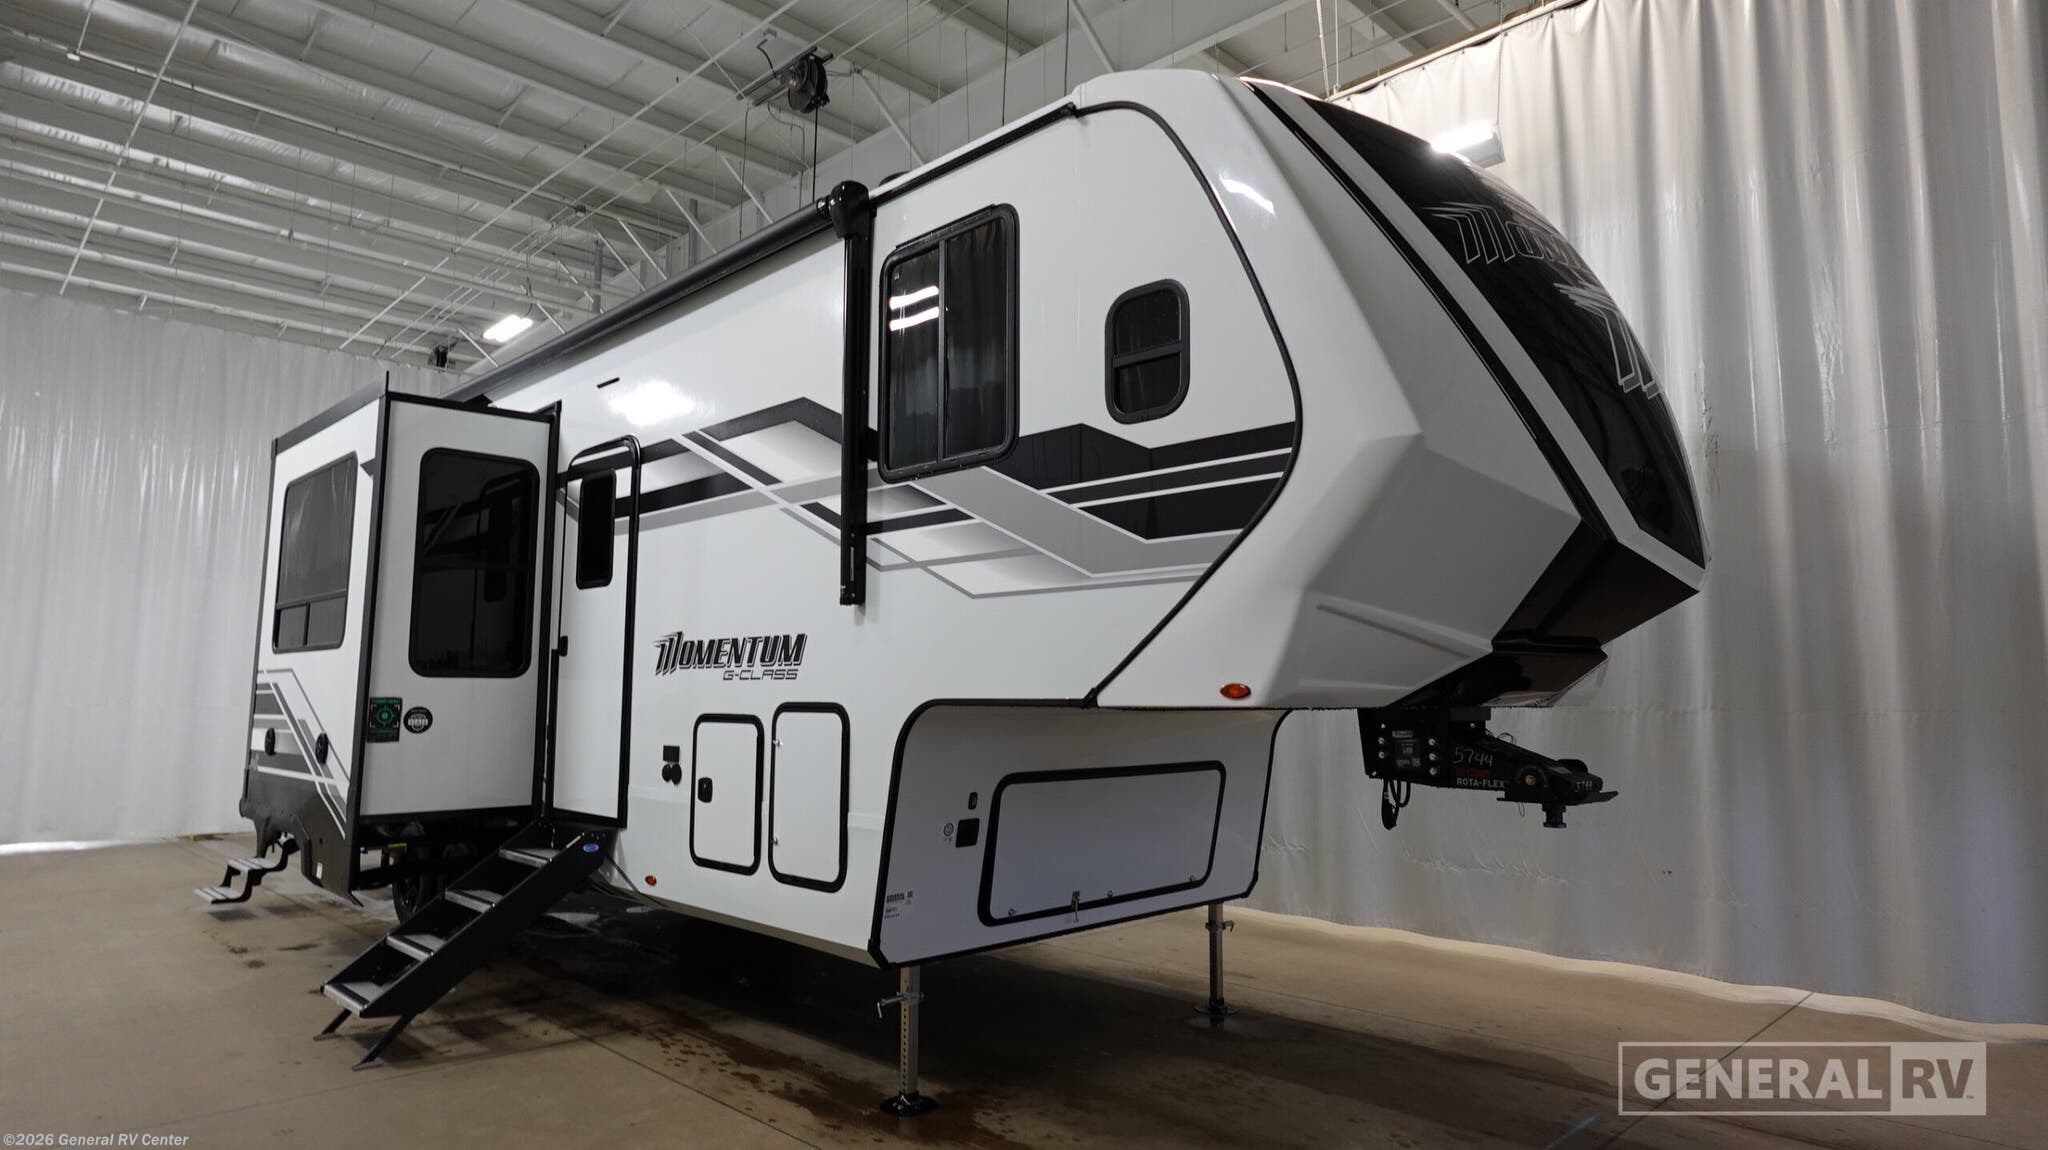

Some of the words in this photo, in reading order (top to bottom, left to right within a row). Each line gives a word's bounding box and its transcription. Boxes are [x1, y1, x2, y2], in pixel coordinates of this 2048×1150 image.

[653, 630, 807, 677] MOMENTUM
[722, 669, 799, 681] G-CLASS
[1452, 747, 1493, 767] 5744
